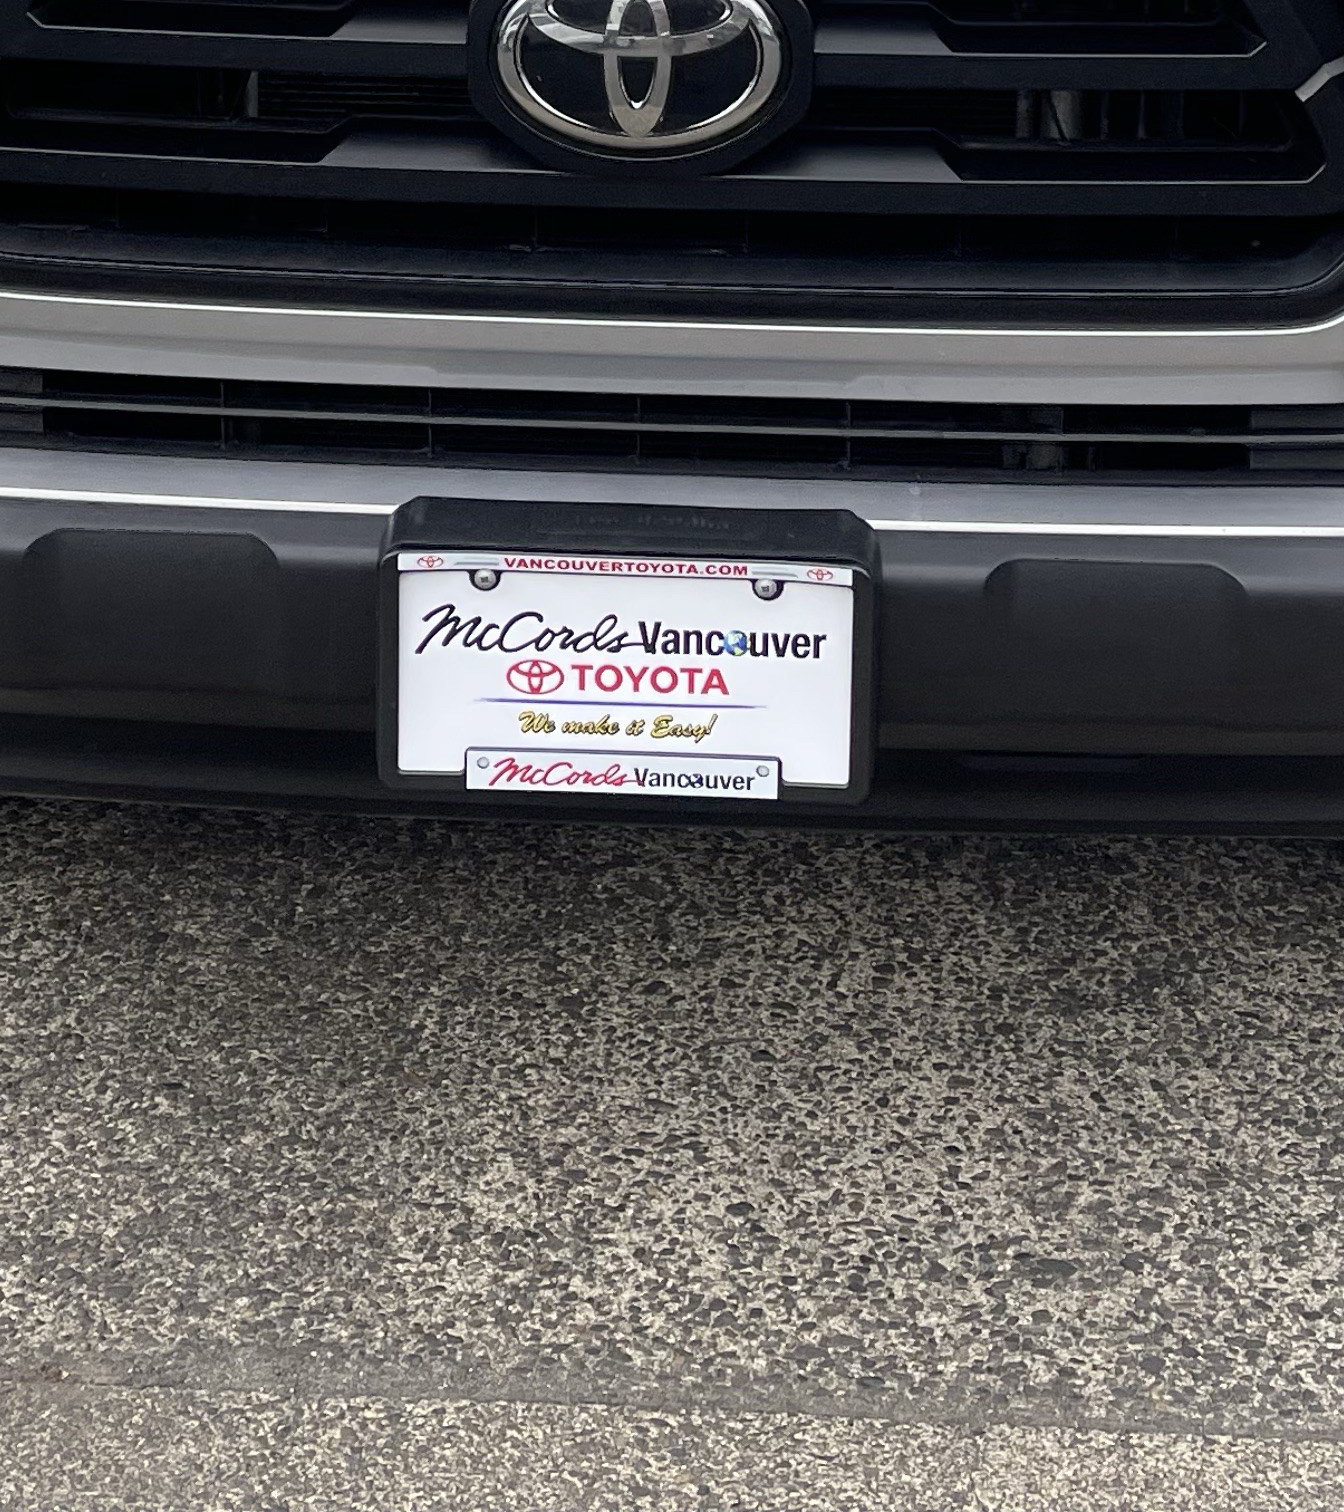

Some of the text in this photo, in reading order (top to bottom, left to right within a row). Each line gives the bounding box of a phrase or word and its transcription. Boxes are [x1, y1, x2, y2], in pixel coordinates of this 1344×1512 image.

[504, 556, 749, 577] VANCOUVERTOYOTA.COM
[571, 663, 730, 696] TOYOTA
[517, 710, 719, 744] We make it Easy!
